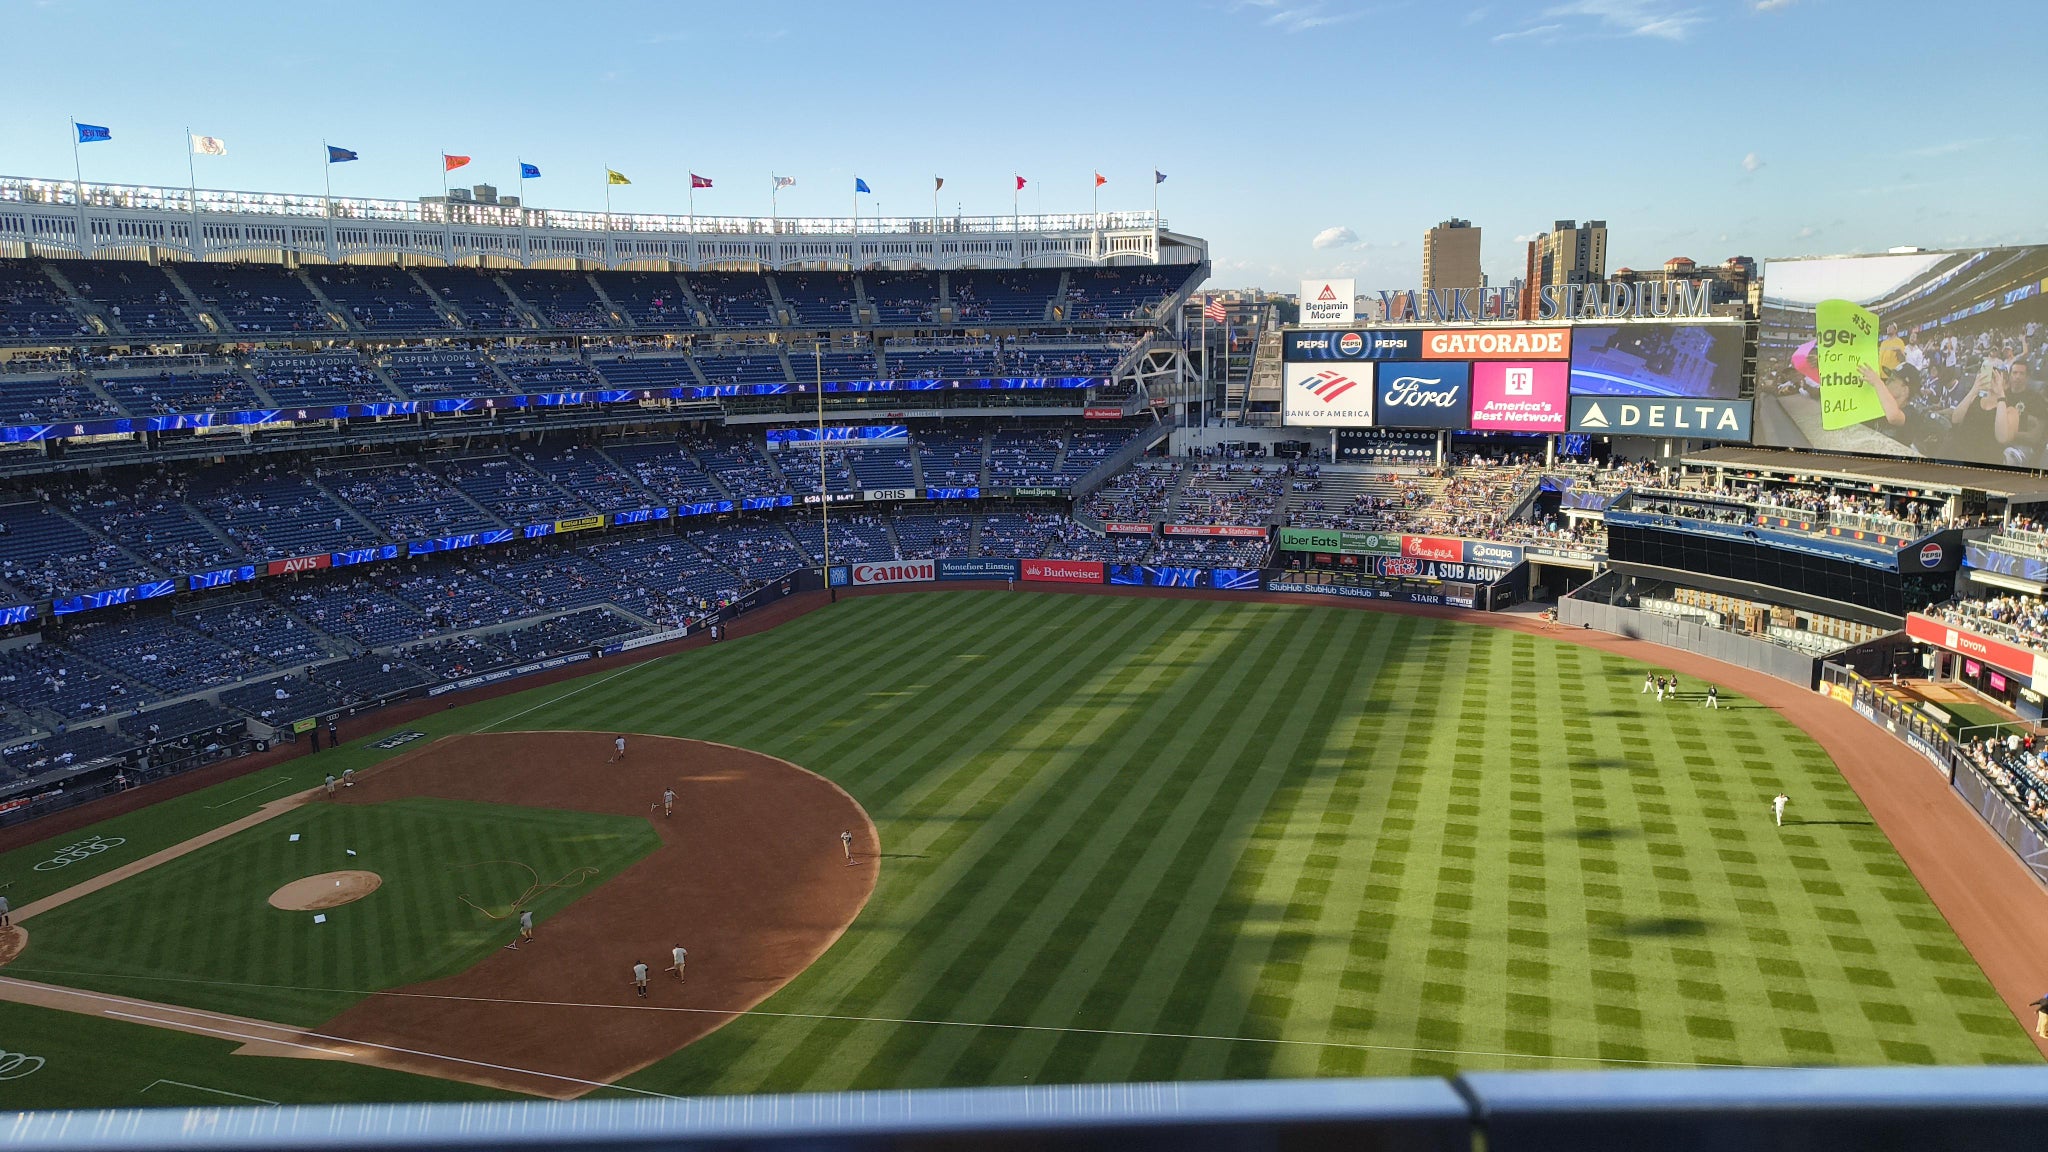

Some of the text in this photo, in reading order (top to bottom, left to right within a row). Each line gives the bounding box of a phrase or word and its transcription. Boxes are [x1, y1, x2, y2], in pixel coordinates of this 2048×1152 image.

[1377, 279, 1712, 321] YANKEE STADIUM
[1306, 302, 1348, 312] Benjamin
[1852, 314, 1872, 336] #35
[1297, 340, 1328, 348] PEPSI
[1375, 340, 1408, 348] PEPSI
[1432, 333, 1562, 352] GATORADE
[270, 358, 354, 367] ASPEN VODKA
[441, 354, 472, 362] VODKA
[1824, 350, 1860, 365] for my
[1384, 376, 1460, 407] Ford
[1484, 400, 1552, 411] America's
[1824, 398, 1857, 414] BALL
[1094, 410, 1121, 418] Budweiser
[1474, 411, 1564, 422] Best Network
[1620, 404, 1739, 430] DELTA
[874, 490, 905, 499] ORIS
[1036, 488, 1056, 496] Spring
[1283, 535, 1309, 545] Uber
[1312, 536, 1338, 546] Eats
[1485, 547, 1512, 558] coupa
[284, 557, 316, 572] AVIS
[1384, 557, 1417, 566] Jersey
[854, 564, 933, 582] Canon
[1428, 562, 1436, 576] A
[1440, 563, 1464, 578] SUB
[1270, 584, 1371, 597] StubHub StubHub StubHub
[1411, 593, 1438, 603] STARR
[1960, 639, 1986, 654] TOYOTA
[1856, 700, 1874, 719] STARR
